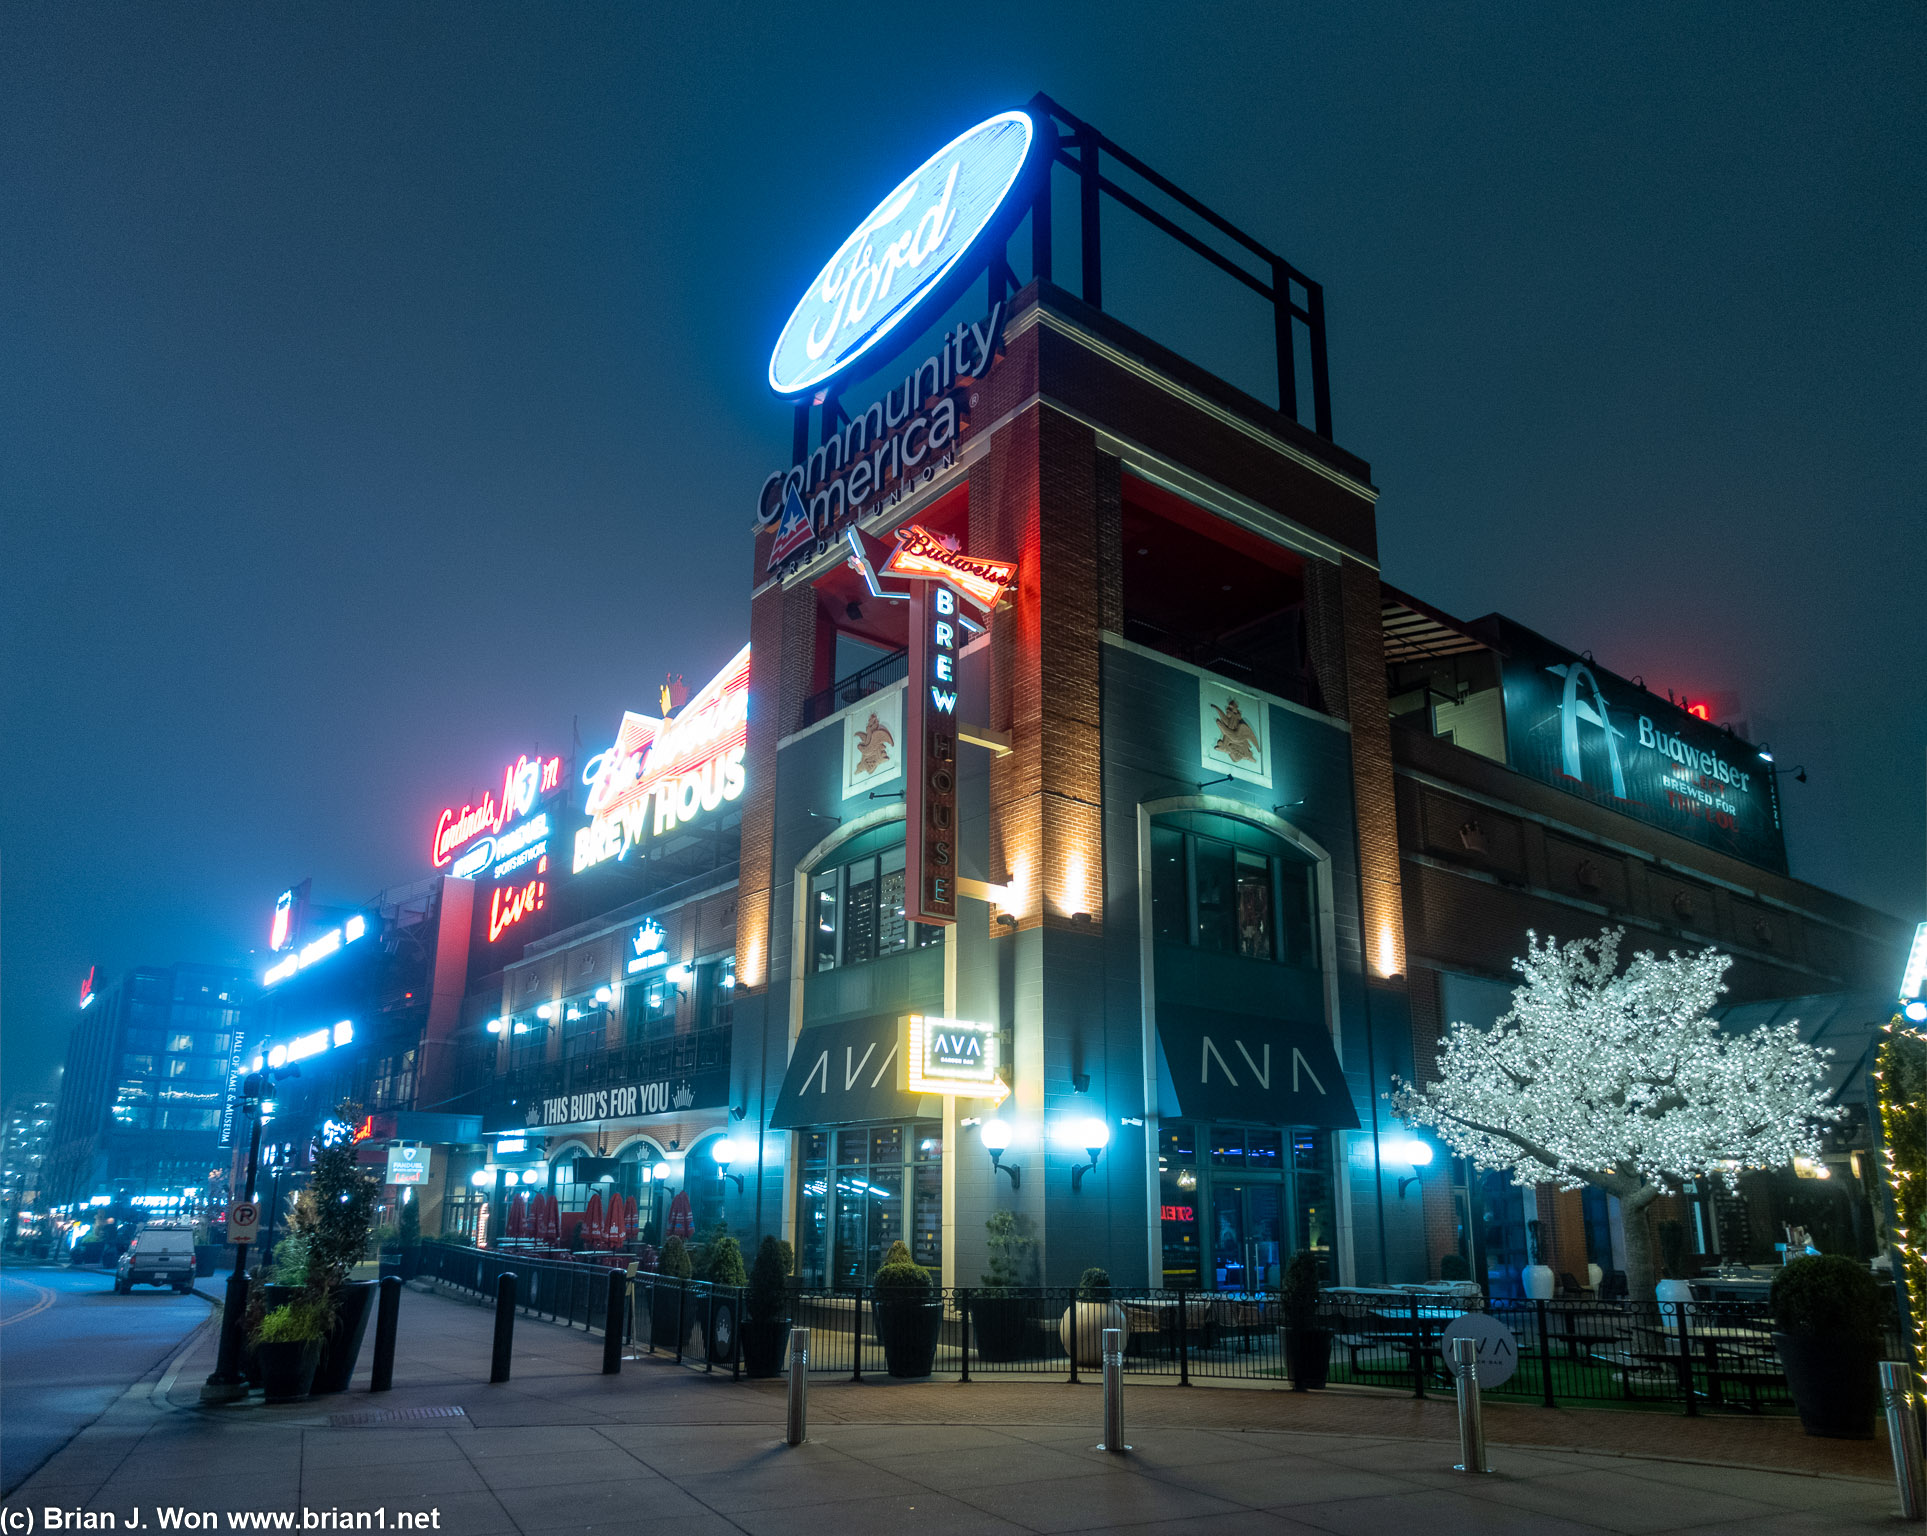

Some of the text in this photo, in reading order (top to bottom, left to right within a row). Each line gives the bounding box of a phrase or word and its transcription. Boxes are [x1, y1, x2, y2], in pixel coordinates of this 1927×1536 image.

[806, 160, 960, 361] Ford
[757, 301, 1002, 524] Community
[775, 451, 957, 583] CREDI UNION
[895, 527, 1019, 588] Budweiser
[931, 587, 958, 904] BREW HOUSE
[1639, 714, 1750, 793] Budweiser
[652, 745, 746, 838] HOUS
[1662, 774, 1737, 817] BREWED FOR
[432, 790, 494, 868] Cardinals
[488, 879, 546, 943] Live!
[231, 1055, 241, 1067] OF
[233, 1031, 245, 1054] HALL
[934, 1033, 981, 1057] AVA
[1201, 1036, 1327, 1095] AVA
[227, 1068, 241, 1092] FAME
[543, 1081, 669, 1125] THIS BUD'S FOR YOU
[220, 1103, 236, 1143] MUSEUM
